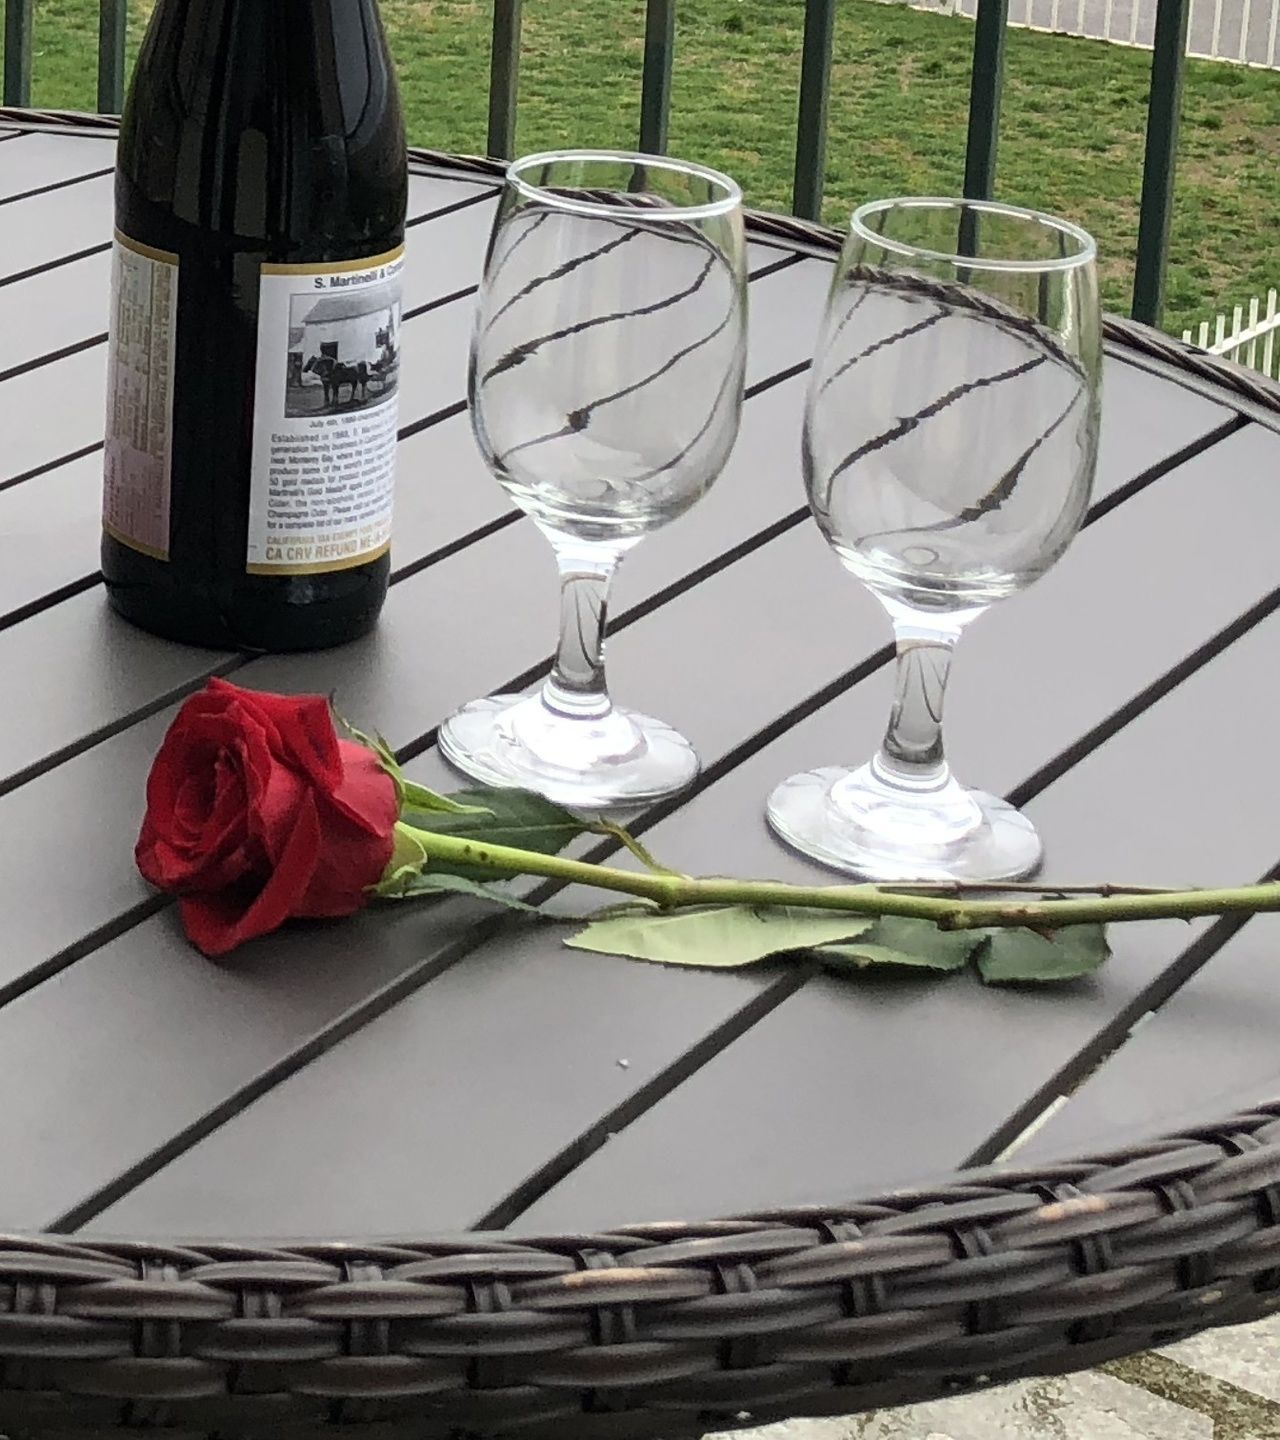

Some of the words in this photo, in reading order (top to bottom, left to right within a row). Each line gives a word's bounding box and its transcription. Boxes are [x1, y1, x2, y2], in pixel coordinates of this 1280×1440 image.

[314, 277, 326, 289] S.
[330, 270, 378, 287] Martinelli
[271, 433, 319, 442] Established
[267, 509, 308, 519] Champagne
[265, 547, 283, 560] CA
[287, 546, 313, 560] CRV
[315, 540, 357, 559] REFUND
